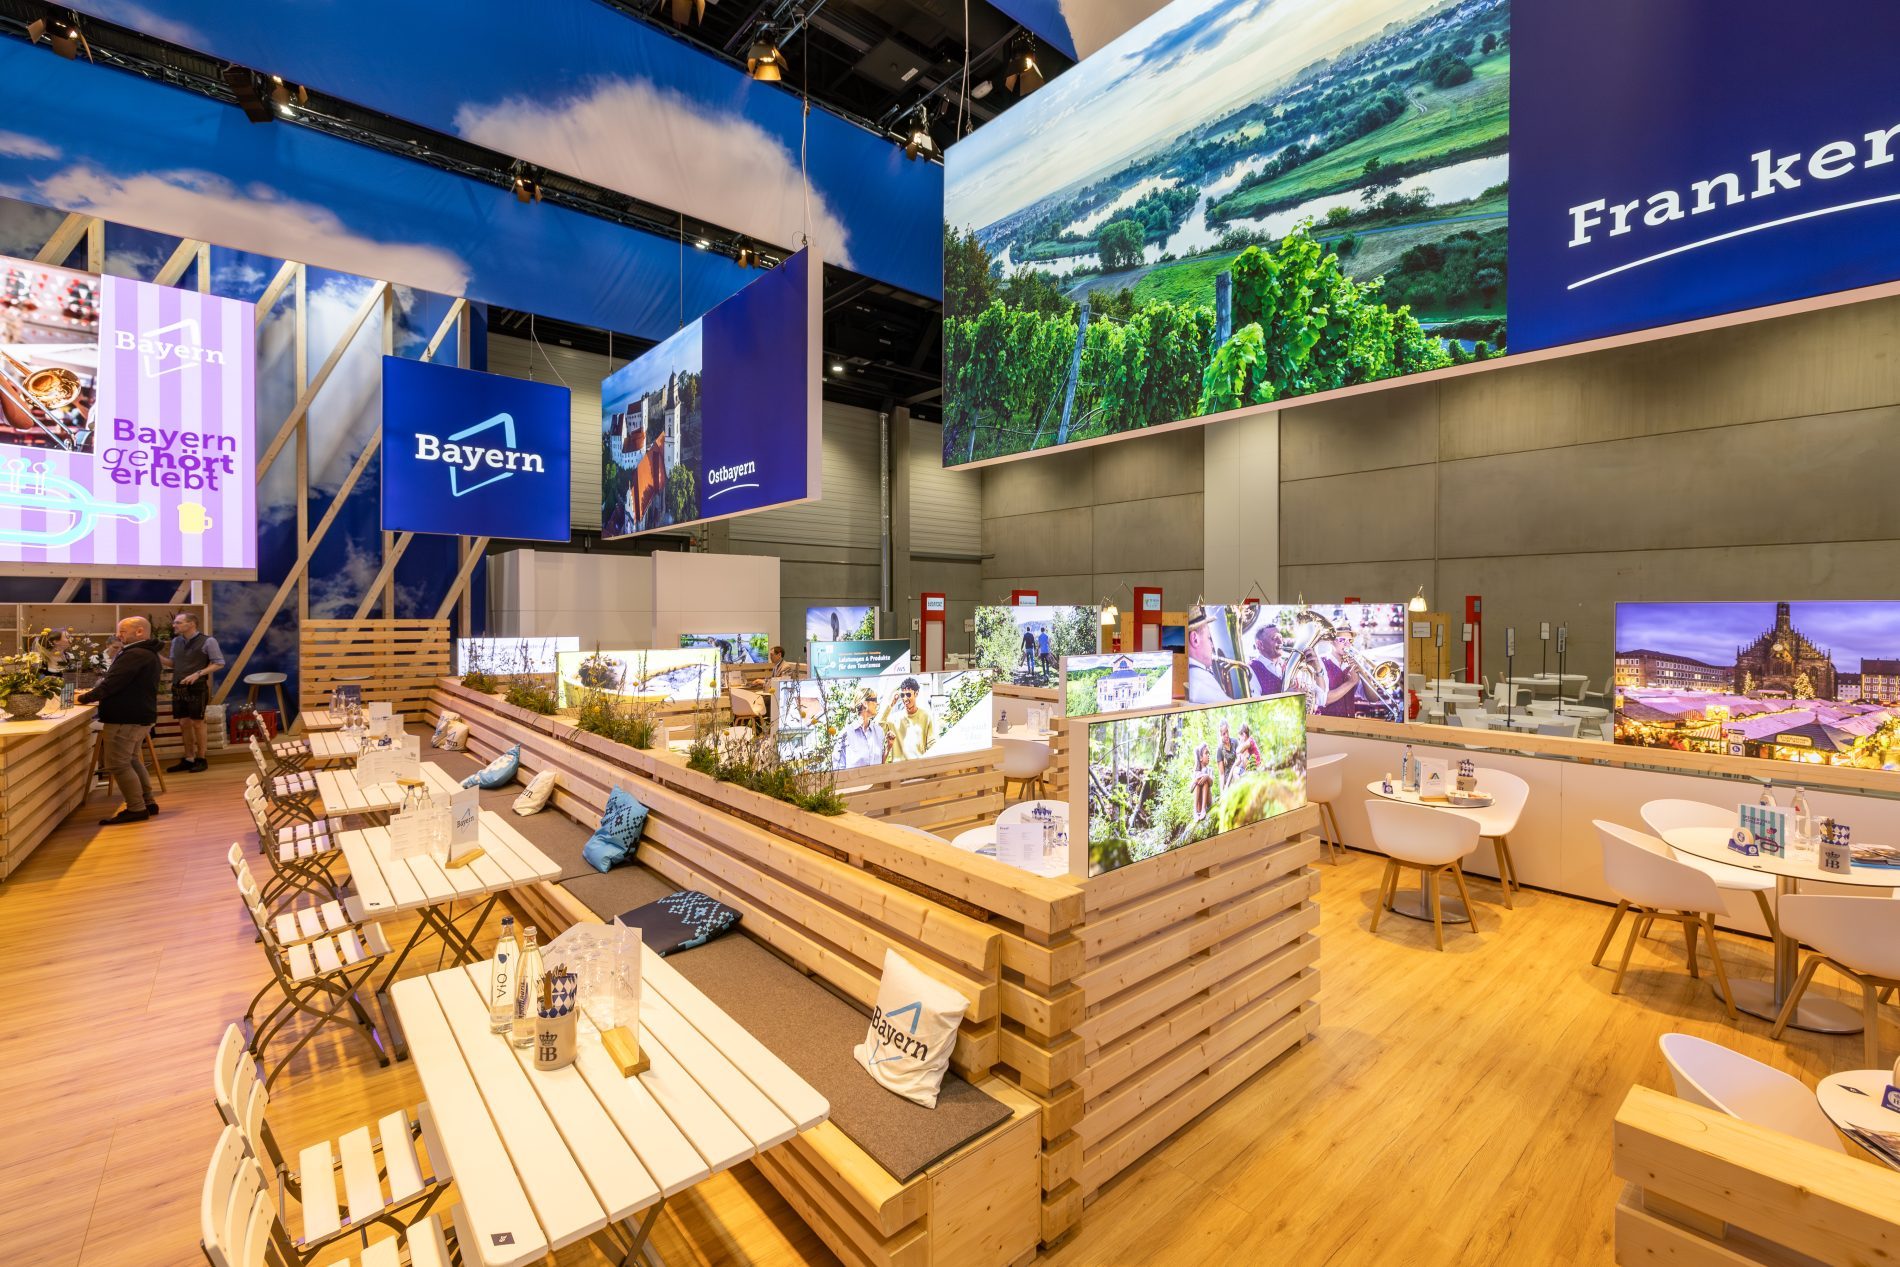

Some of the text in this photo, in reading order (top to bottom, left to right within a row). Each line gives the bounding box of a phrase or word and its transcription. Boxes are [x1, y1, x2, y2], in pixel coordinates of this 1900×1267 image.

[114, 330, 226, 365] Bayern
[113, 418, 236, 452] Bayern
[102, 445, 234, 474] gehört
[414, 432, 545, 473] Bayern
[110, 463, 219, 491] erlebt
[708, 460, 756, 485] Ostbayern
[838, 663, 846, 671] für
[857, 662, 881, 670] Tourismus
[870, 654, 891, 662] Produkte
[456, 815, 475, 829] Bayern
[872, 1005, 929, 1062] Bayern
[539, 1046, 558, 1062] HB
